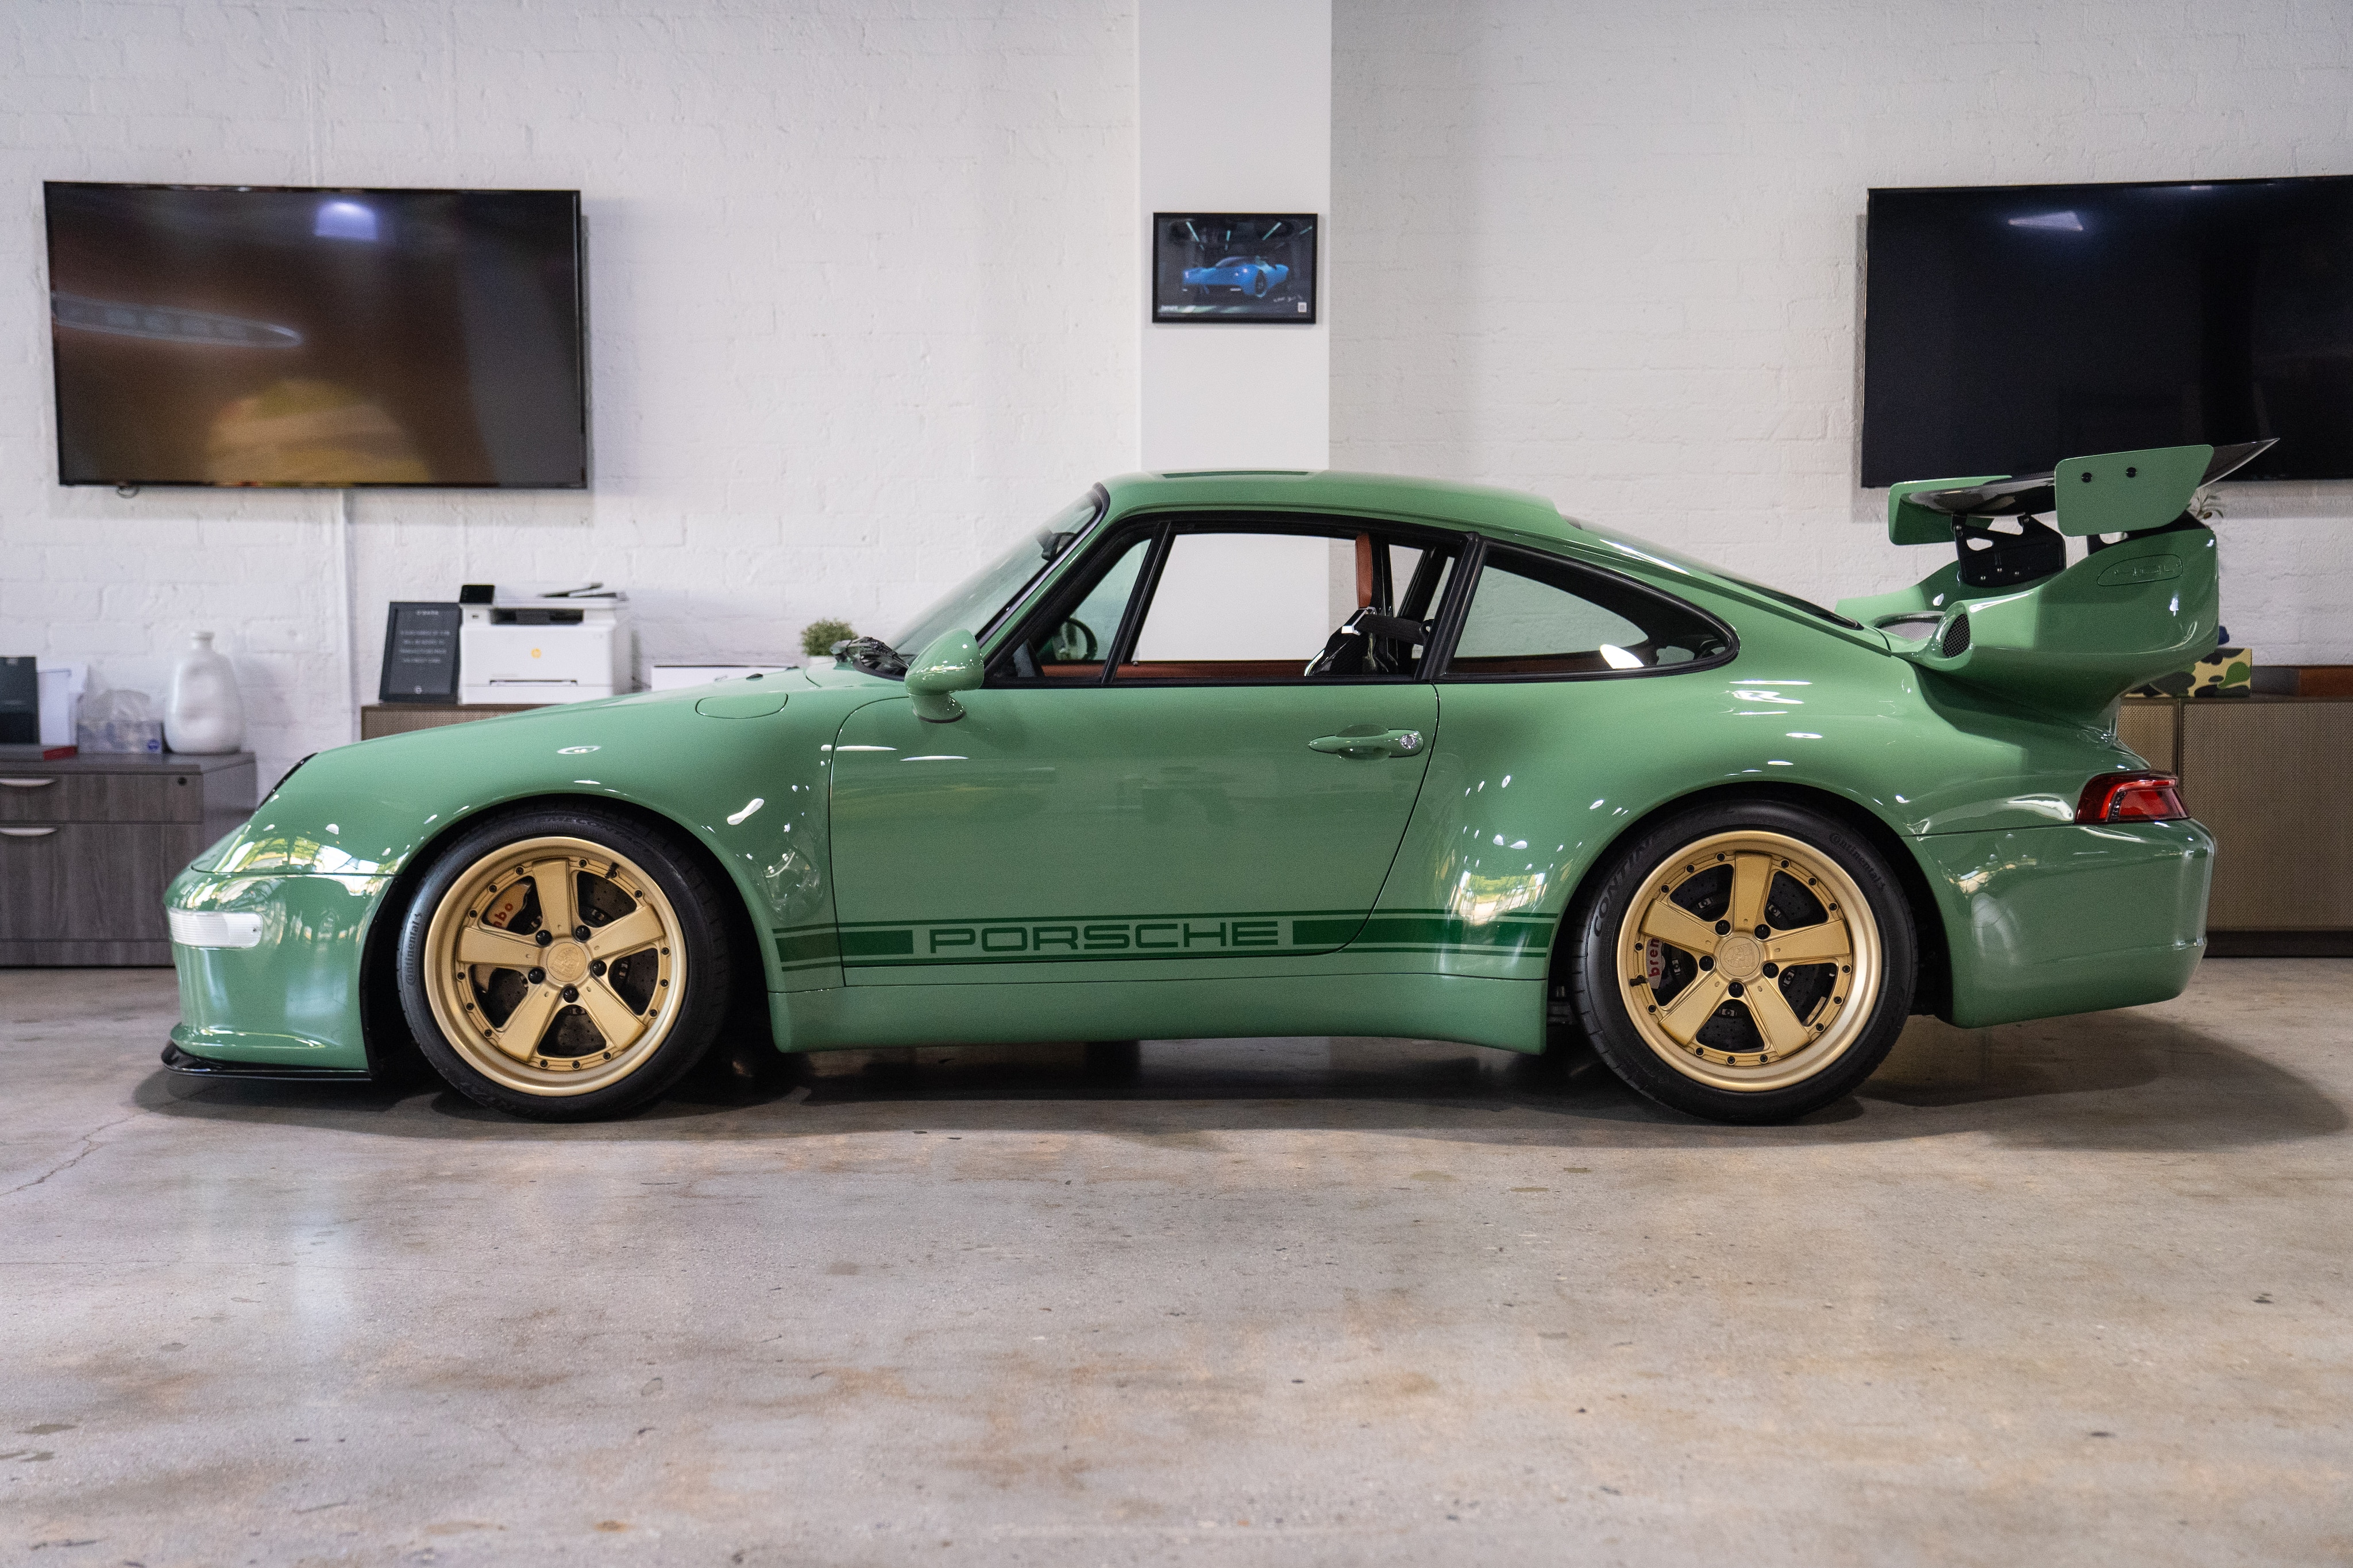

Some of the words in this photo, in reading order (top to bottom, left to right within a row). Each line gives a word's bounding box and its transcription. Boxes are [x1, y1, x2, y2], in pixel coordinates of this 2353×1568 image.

[1829, 832, 1882, 883] Continental
[405, 920, 420, 986] Continental
[929, 921, 1278, 953] PORSCHE
